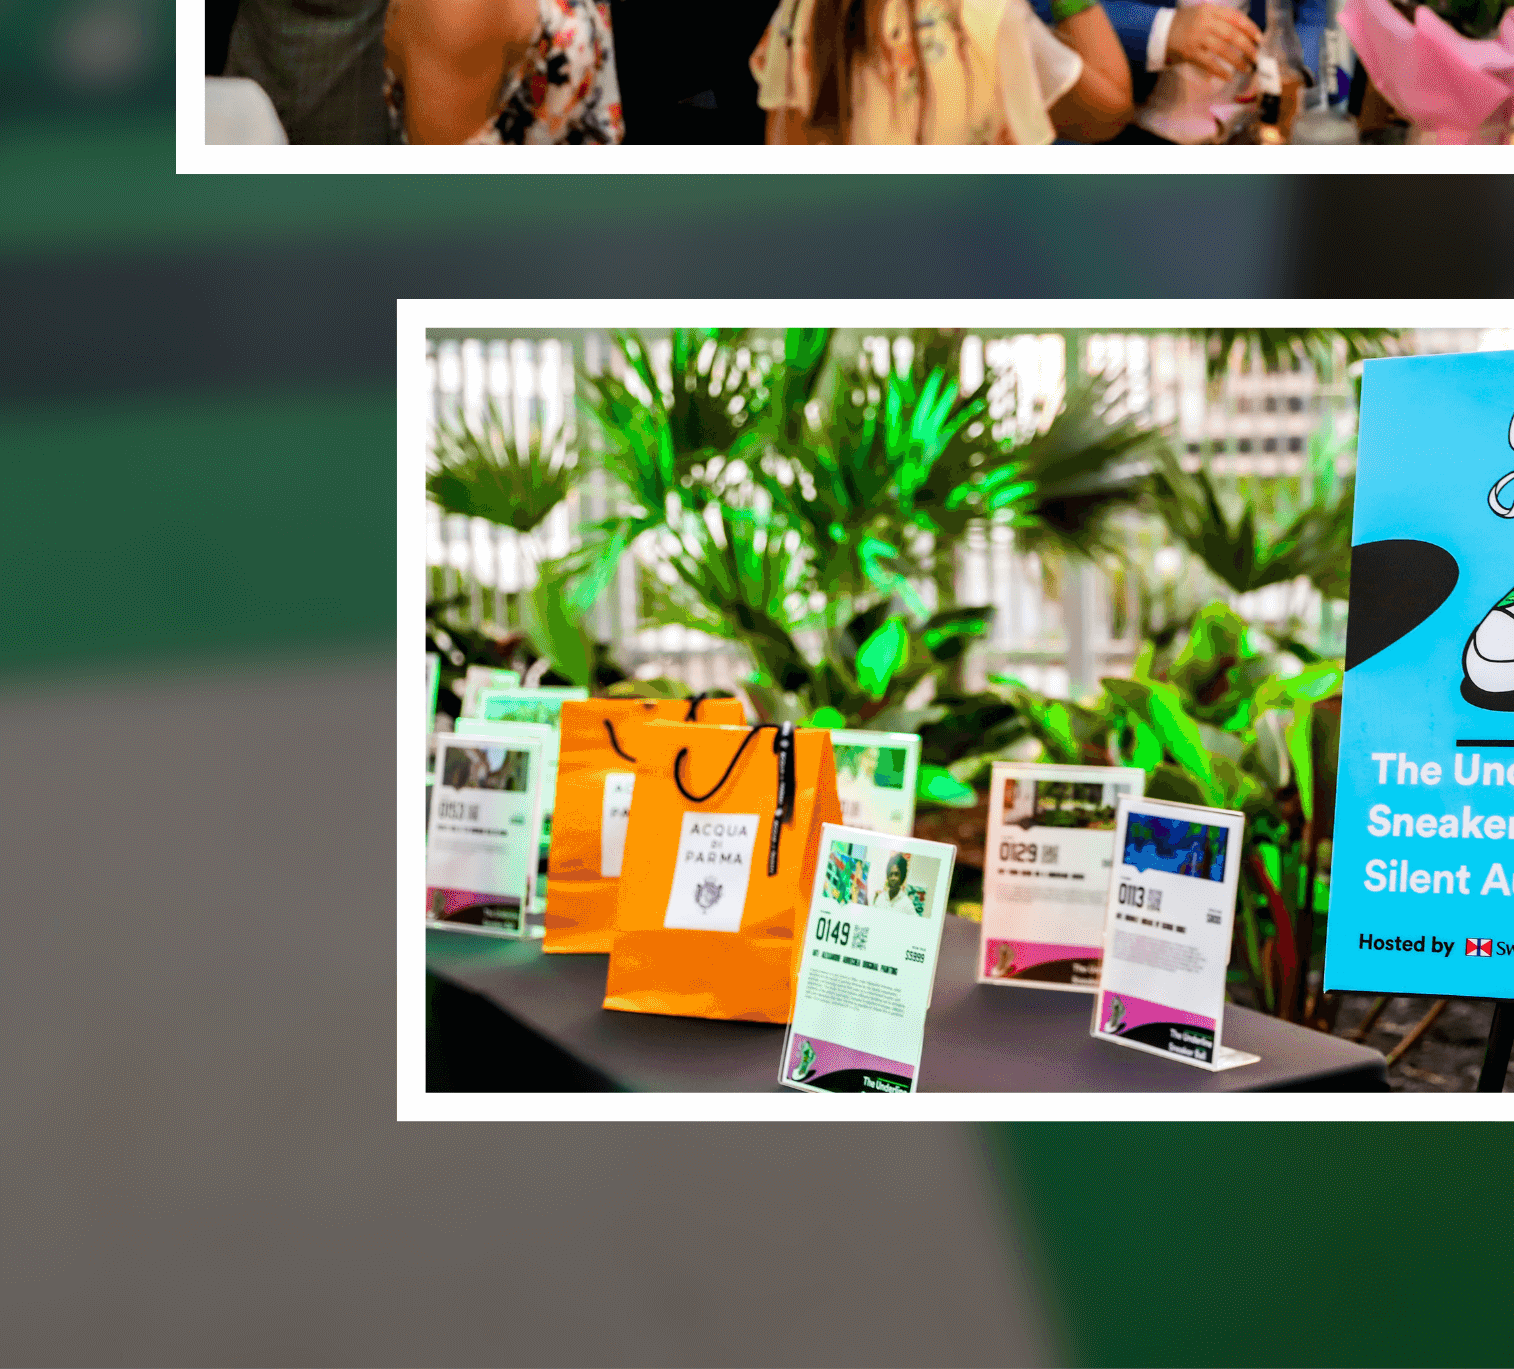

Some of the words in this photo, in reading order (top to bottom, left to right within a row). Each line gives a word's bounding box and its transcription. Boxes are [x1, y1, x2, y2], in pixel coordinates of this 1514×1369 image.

[1371, 752, 1443, 785] The
[690, 823, 748, 837] ACQUA
[685, 850, 743, 864] PARMA
[999, 841, 1037, 862] 0129
[1364, 858, 1471, 895] Silent
[815, 917, 851, 946] 0149
[1359, 933, 1425, 953] Hosted
[1431, 936, 1455, 957] by
[863, 1075, 875, 1088] The
